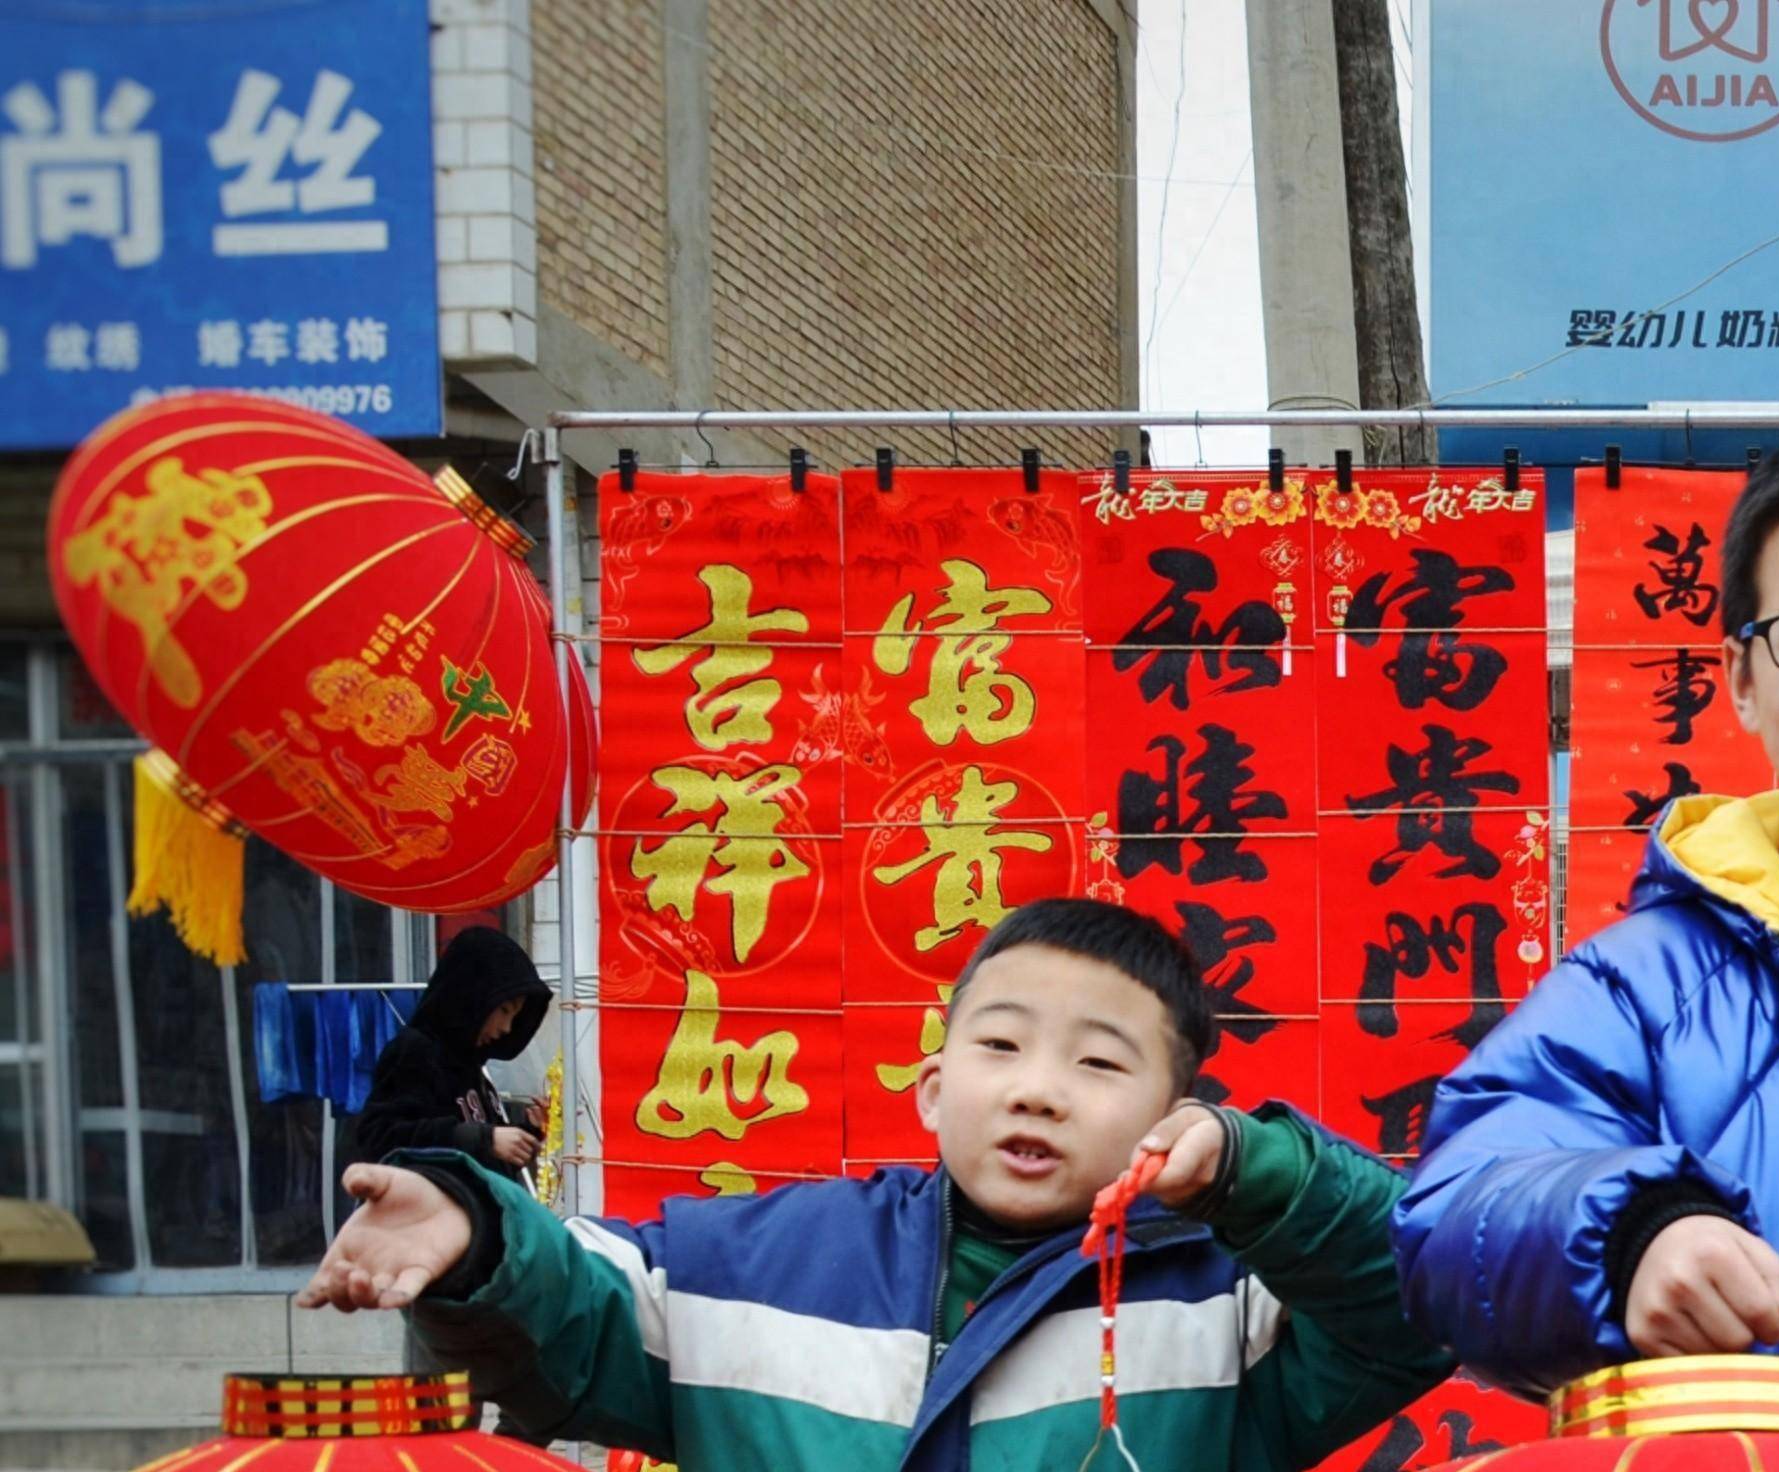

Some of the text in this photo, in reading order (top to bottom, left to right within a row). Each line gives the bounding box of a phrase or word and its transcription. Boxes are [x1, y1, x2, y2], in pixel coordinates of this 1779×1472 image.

[1, 68, 389, 270] 尚丝
[1650, 75, 1779, 108] AIJIA
[632, 564, 810, 1195] 吉祥如
